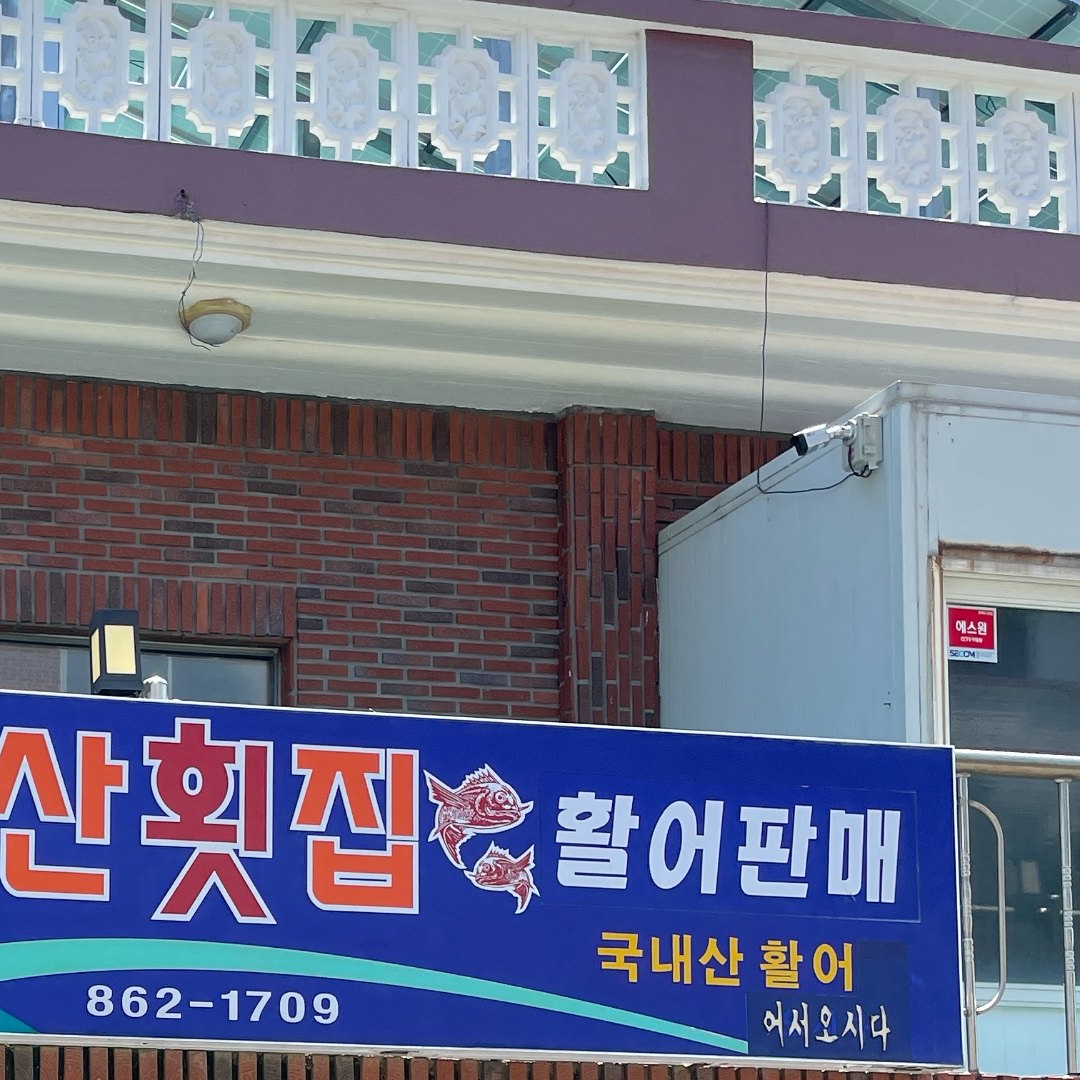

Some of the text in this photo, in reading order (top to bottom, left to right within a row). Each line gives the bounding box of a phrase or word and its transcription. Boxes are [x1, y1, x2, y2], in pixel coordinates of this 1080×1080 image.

[955, 620, 987, 635] 에스원
[949, 649, 976, 659] SECOM
[554, 790, 902, 904] 활어판매
[596, 930, 855, 992] 국내산 활어
[86, 984, 341, 1026] 862-1709
